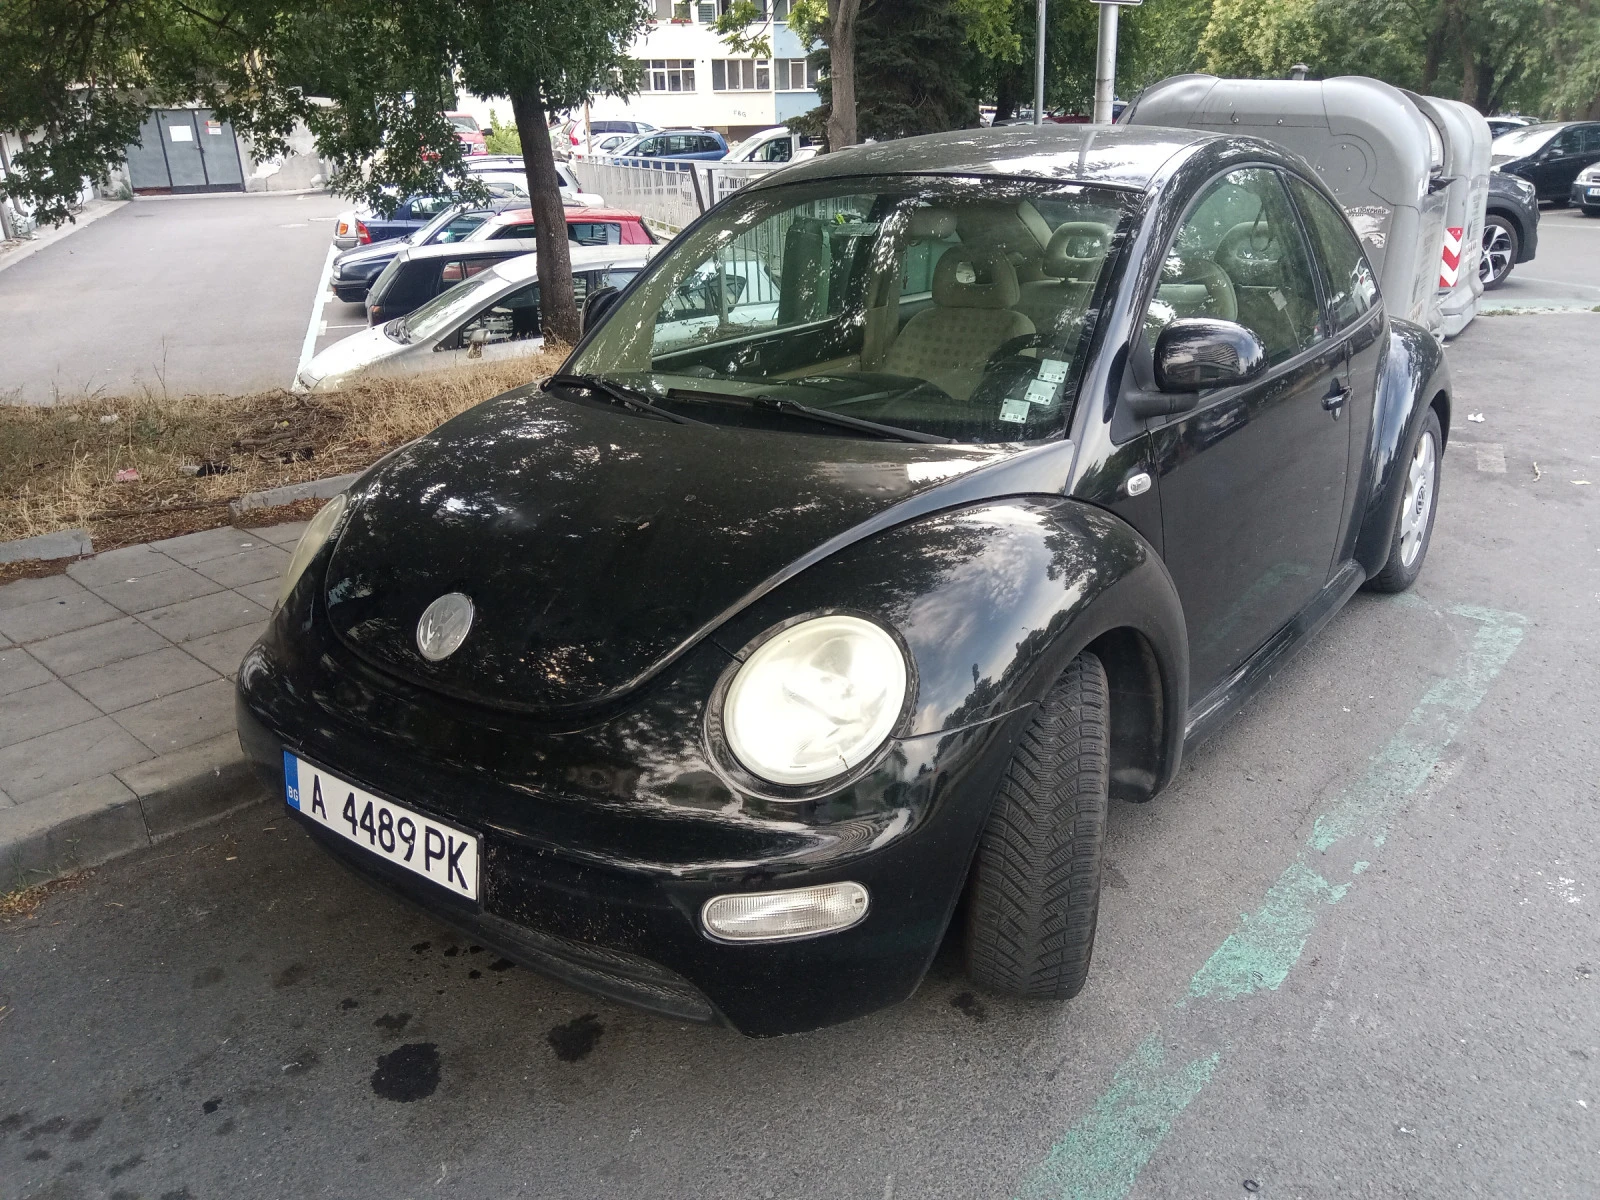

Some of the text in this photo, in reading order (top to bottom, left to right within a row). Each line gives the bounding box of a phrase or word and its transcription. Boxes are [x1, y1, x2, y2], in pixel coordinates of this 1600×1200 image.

[288, 785, 299, 802] BG
[312, 774, 469, 891] A 4489 PK
